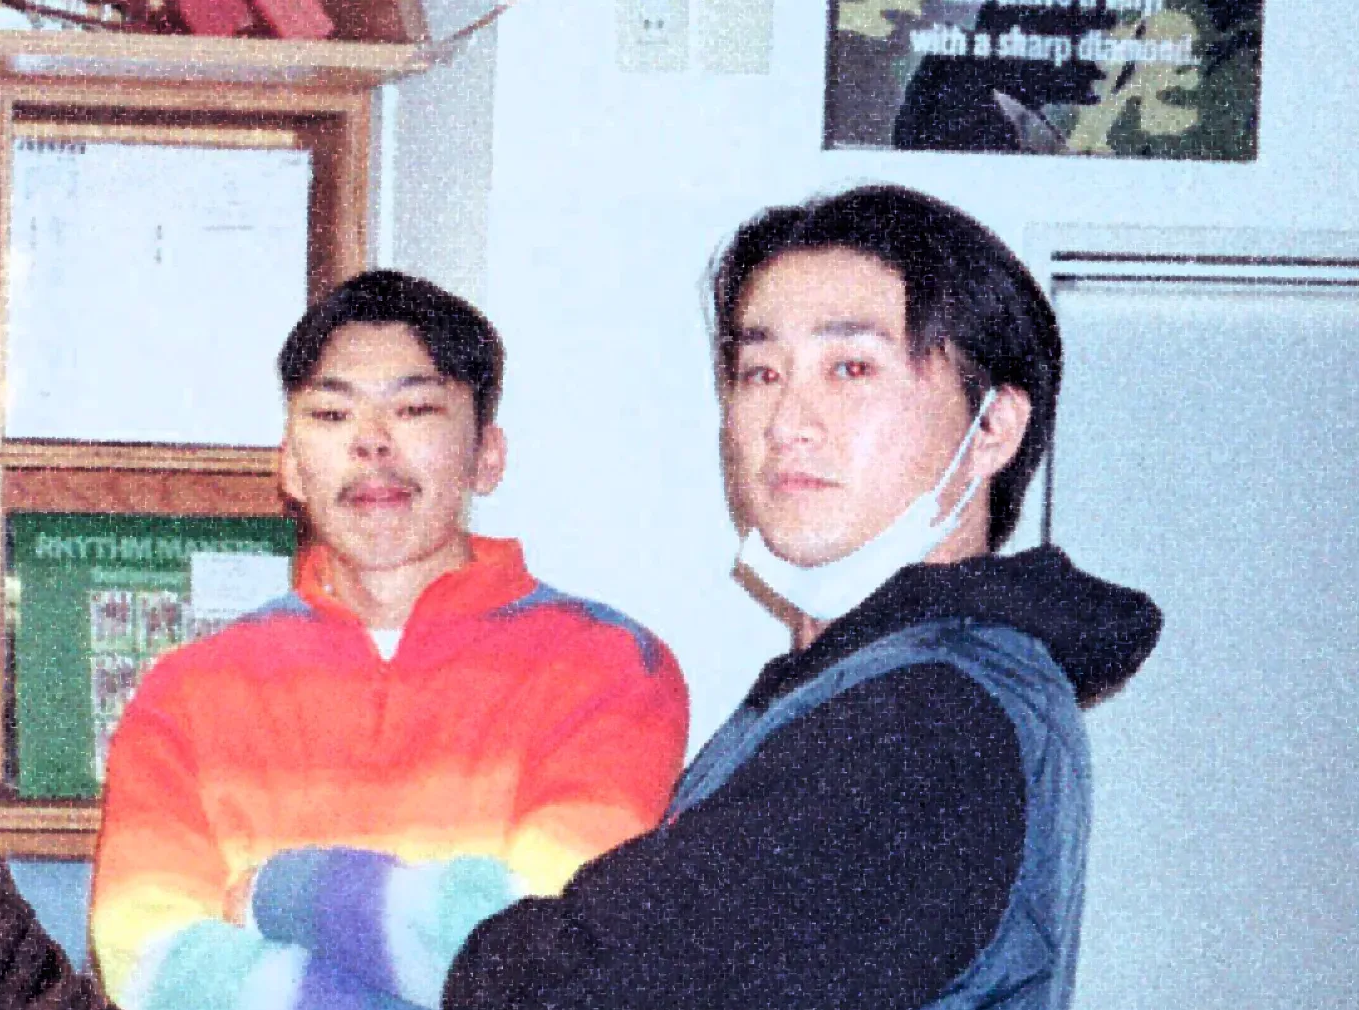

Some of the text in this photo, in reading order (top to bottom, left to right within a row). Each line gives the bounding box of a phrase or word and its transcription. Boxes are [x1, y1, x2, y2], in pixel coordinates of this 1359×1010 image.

[908, 24, 967, 55] with
[973, 34, 991, 56] a
[998, 25, 1072, 66] sharp
[35, 532, 152, 560] RHYTHM
